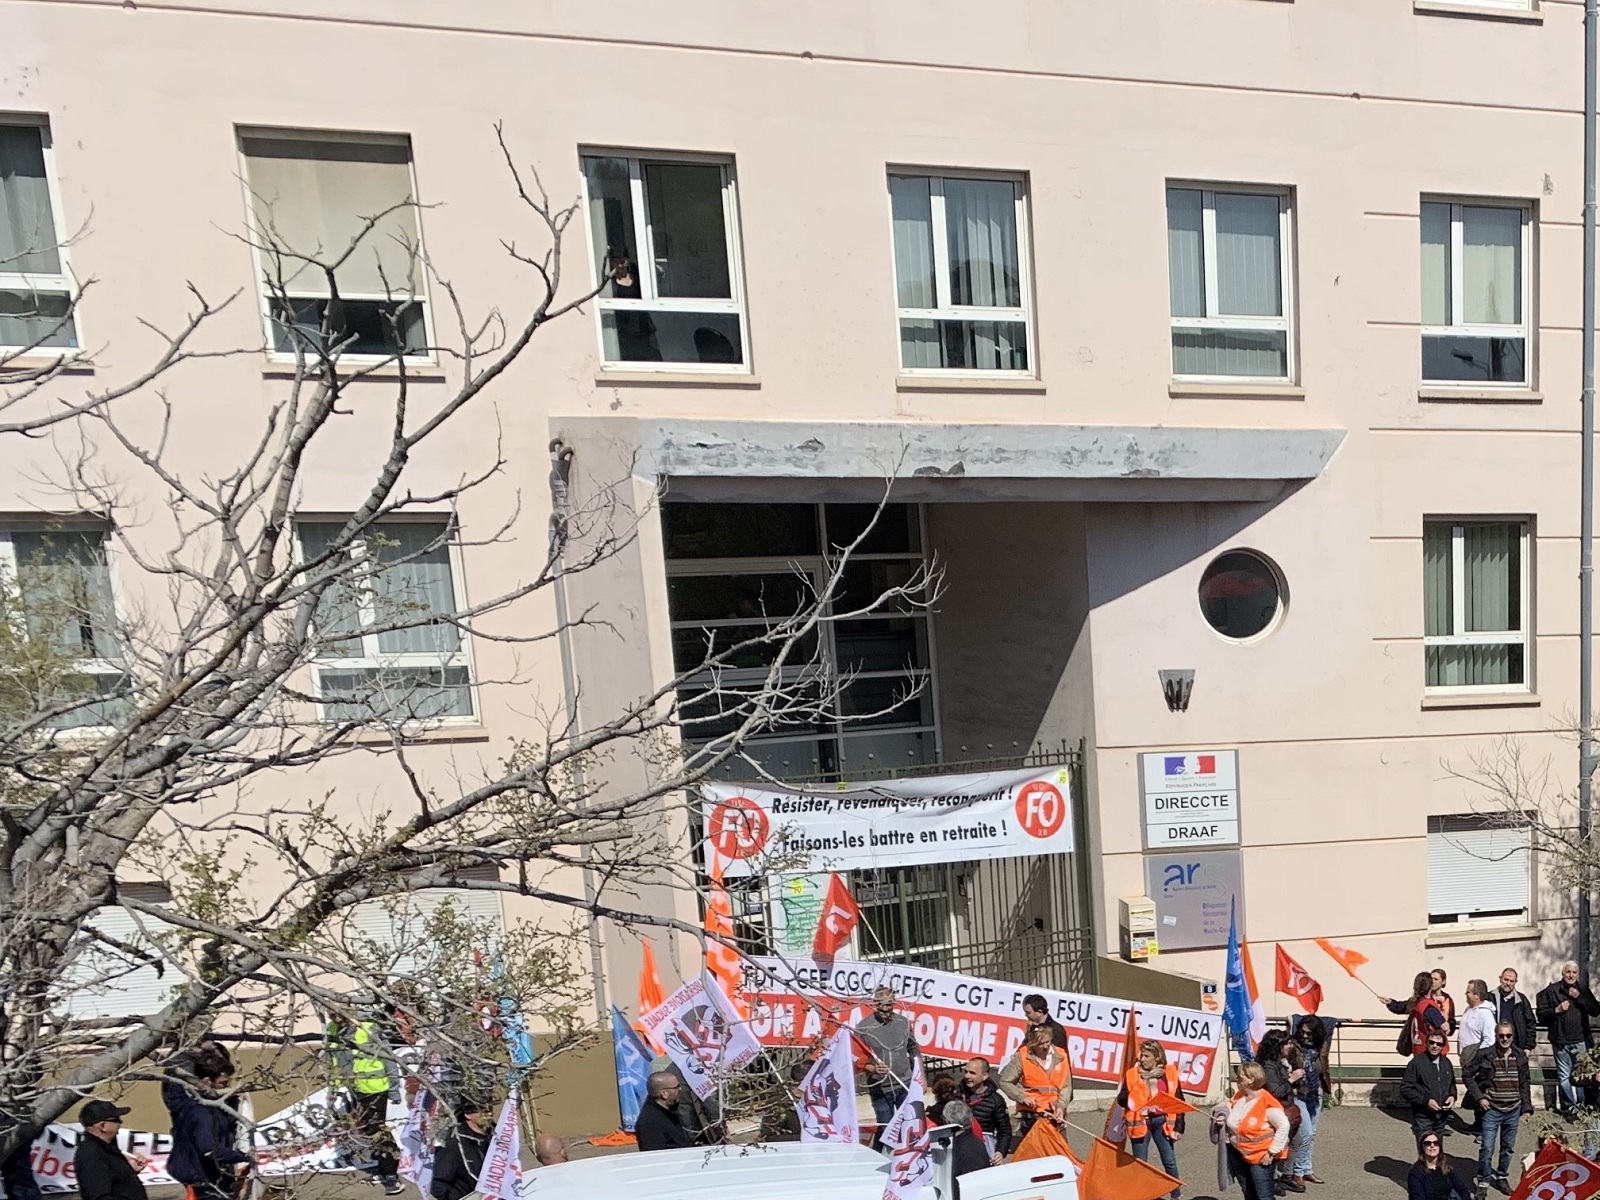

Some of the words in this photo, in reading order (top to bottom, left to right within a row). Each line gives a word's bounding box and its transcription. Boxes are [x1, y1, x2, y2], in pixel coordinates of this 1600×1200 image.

[1026, 791, 1058, 828] FO
[1155, 795, 1229, 810] DIRECCTE
[870, 829, 915, 847] battre
[920, 829, 937, 842] en
[943, 822, 997, 841] retraite
[1168, 825, 1218, 839] DRAAF
[955, 984, 993, 1008] CGT
[1057, 999, 1091, 1022] FSU
[1161, 1015, 1210, 1041] UNSA
